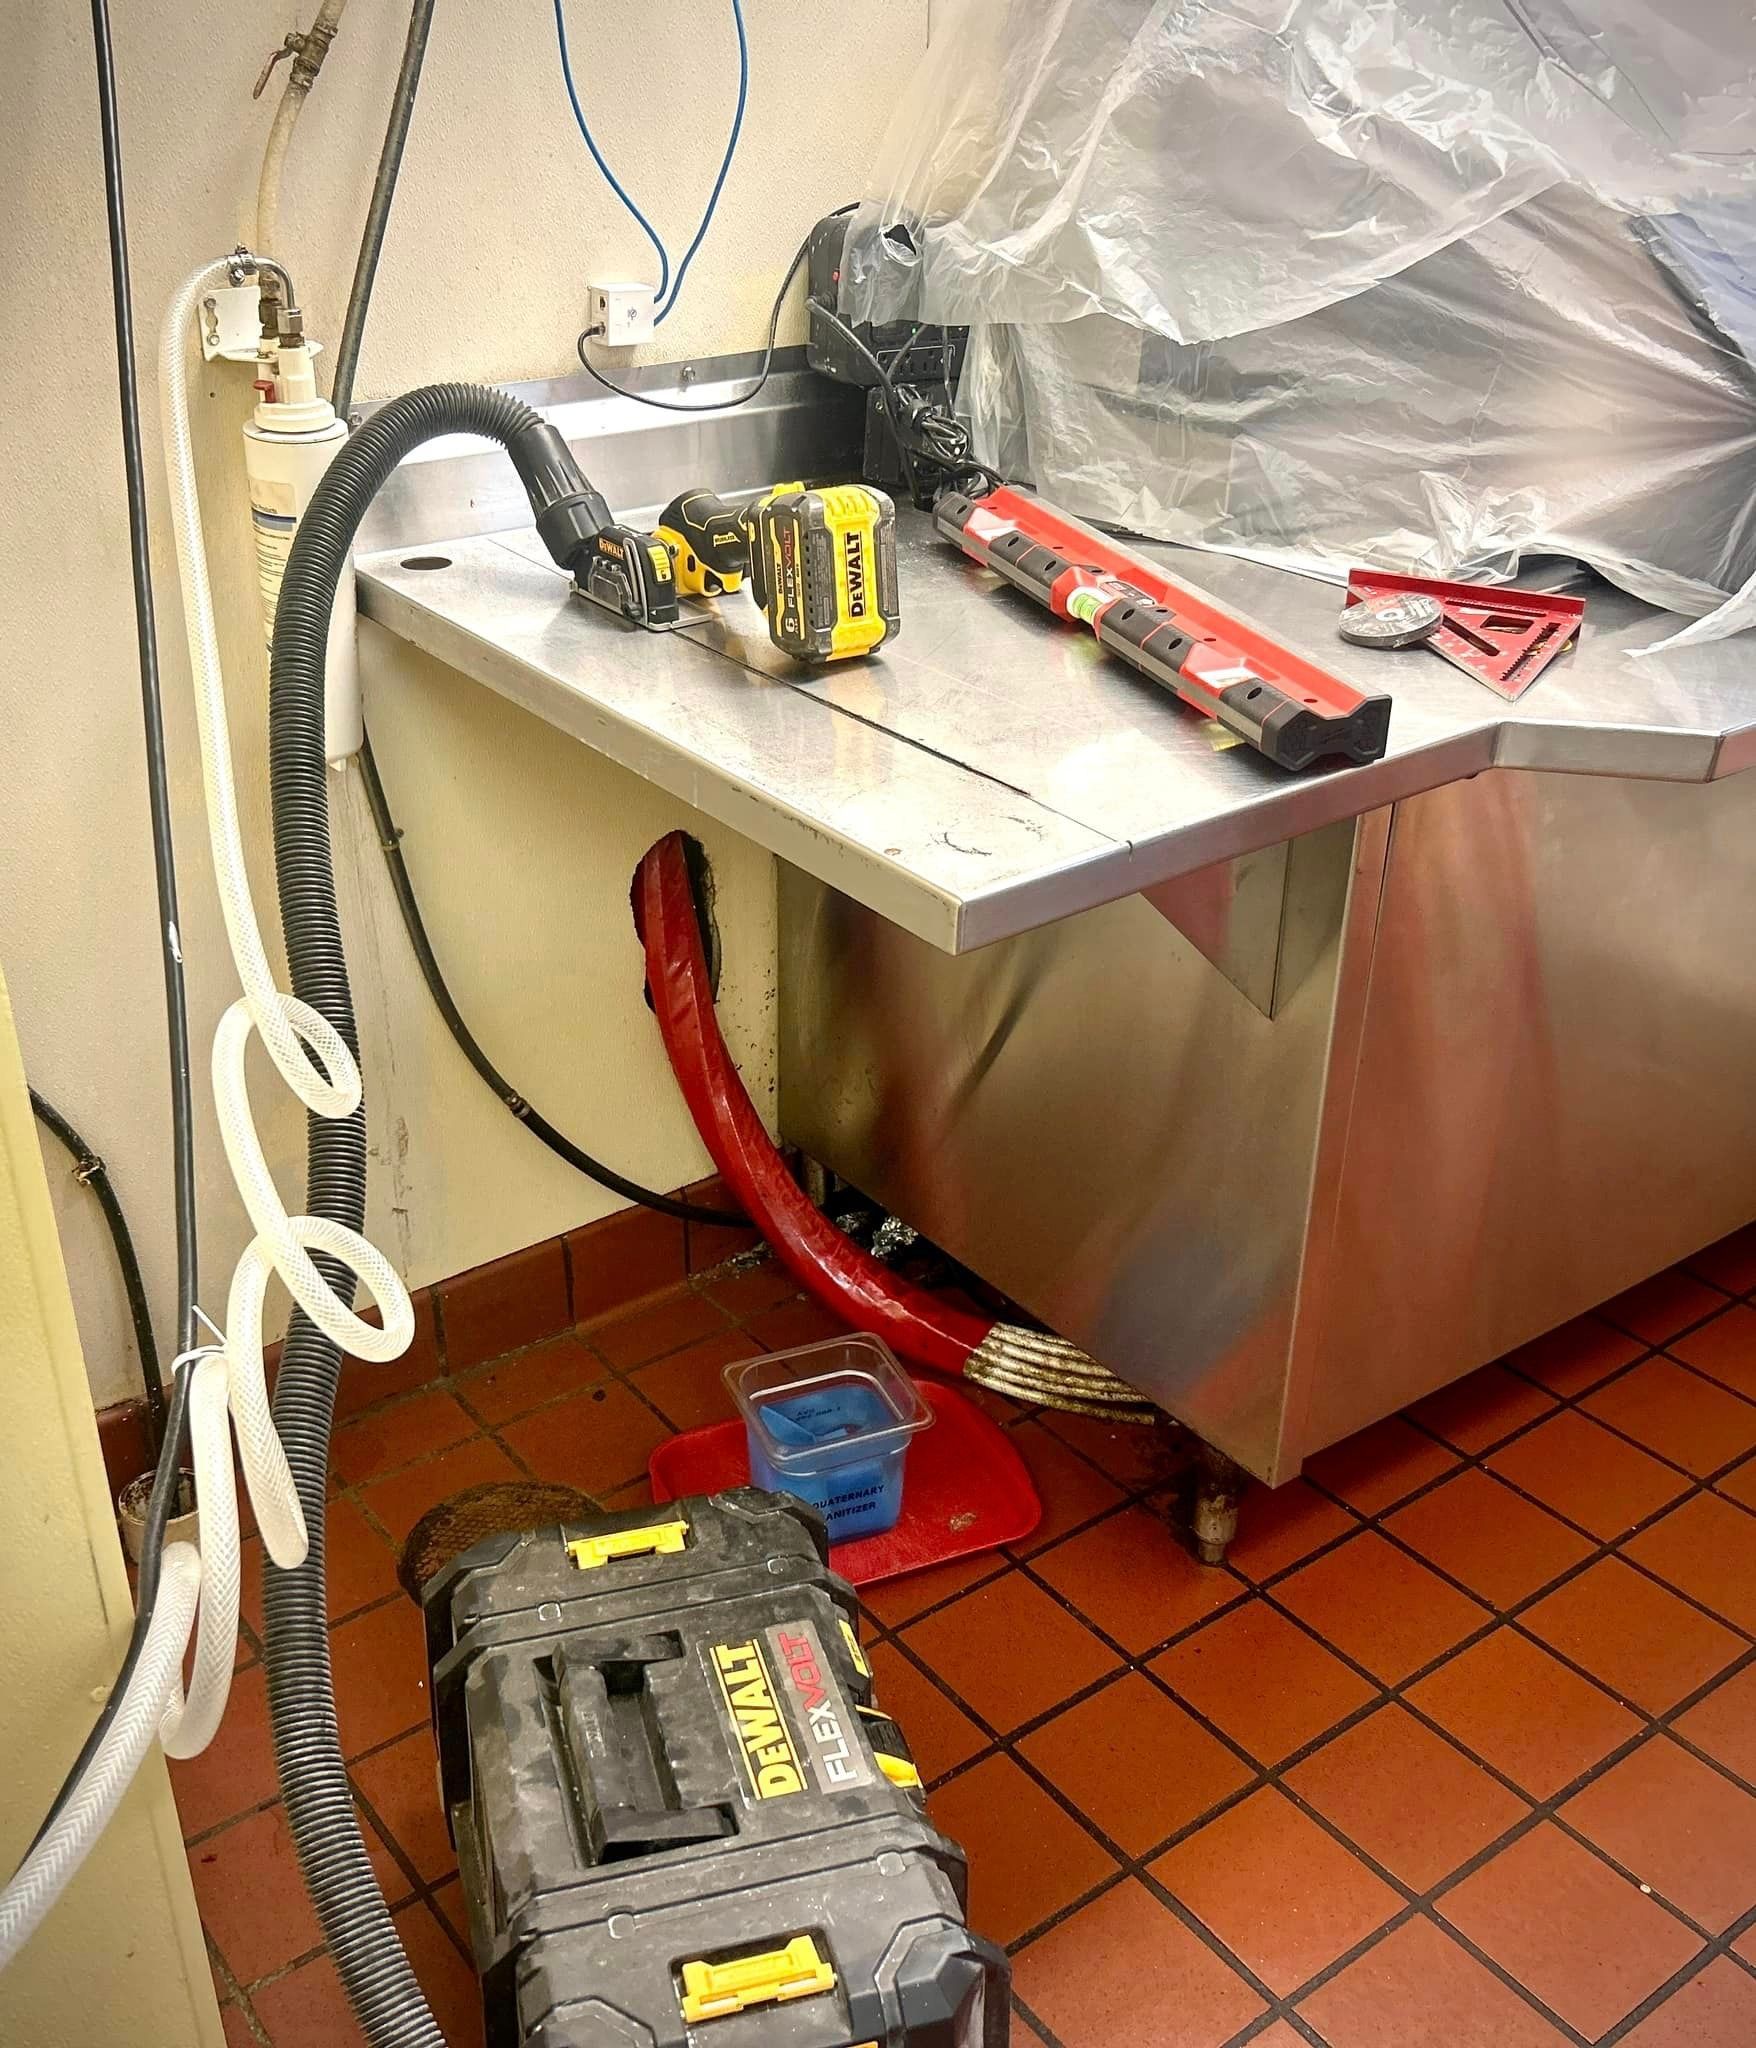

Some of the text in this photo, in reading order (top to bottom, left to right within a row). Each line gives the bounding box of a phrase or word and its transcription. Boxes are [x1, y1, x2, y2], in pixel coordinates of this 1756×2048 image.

[784, 528, 796, 608] FLEXVOLT
[847, 532, 865, 617] DEWALT
[785, 618, 795, 633] 6
[826, 1501, 877, 1521] ANITIZER
[715, 1644, 802, 1798] DEWALT
[778, 1632, 858, 1784] FLEXVOLT
